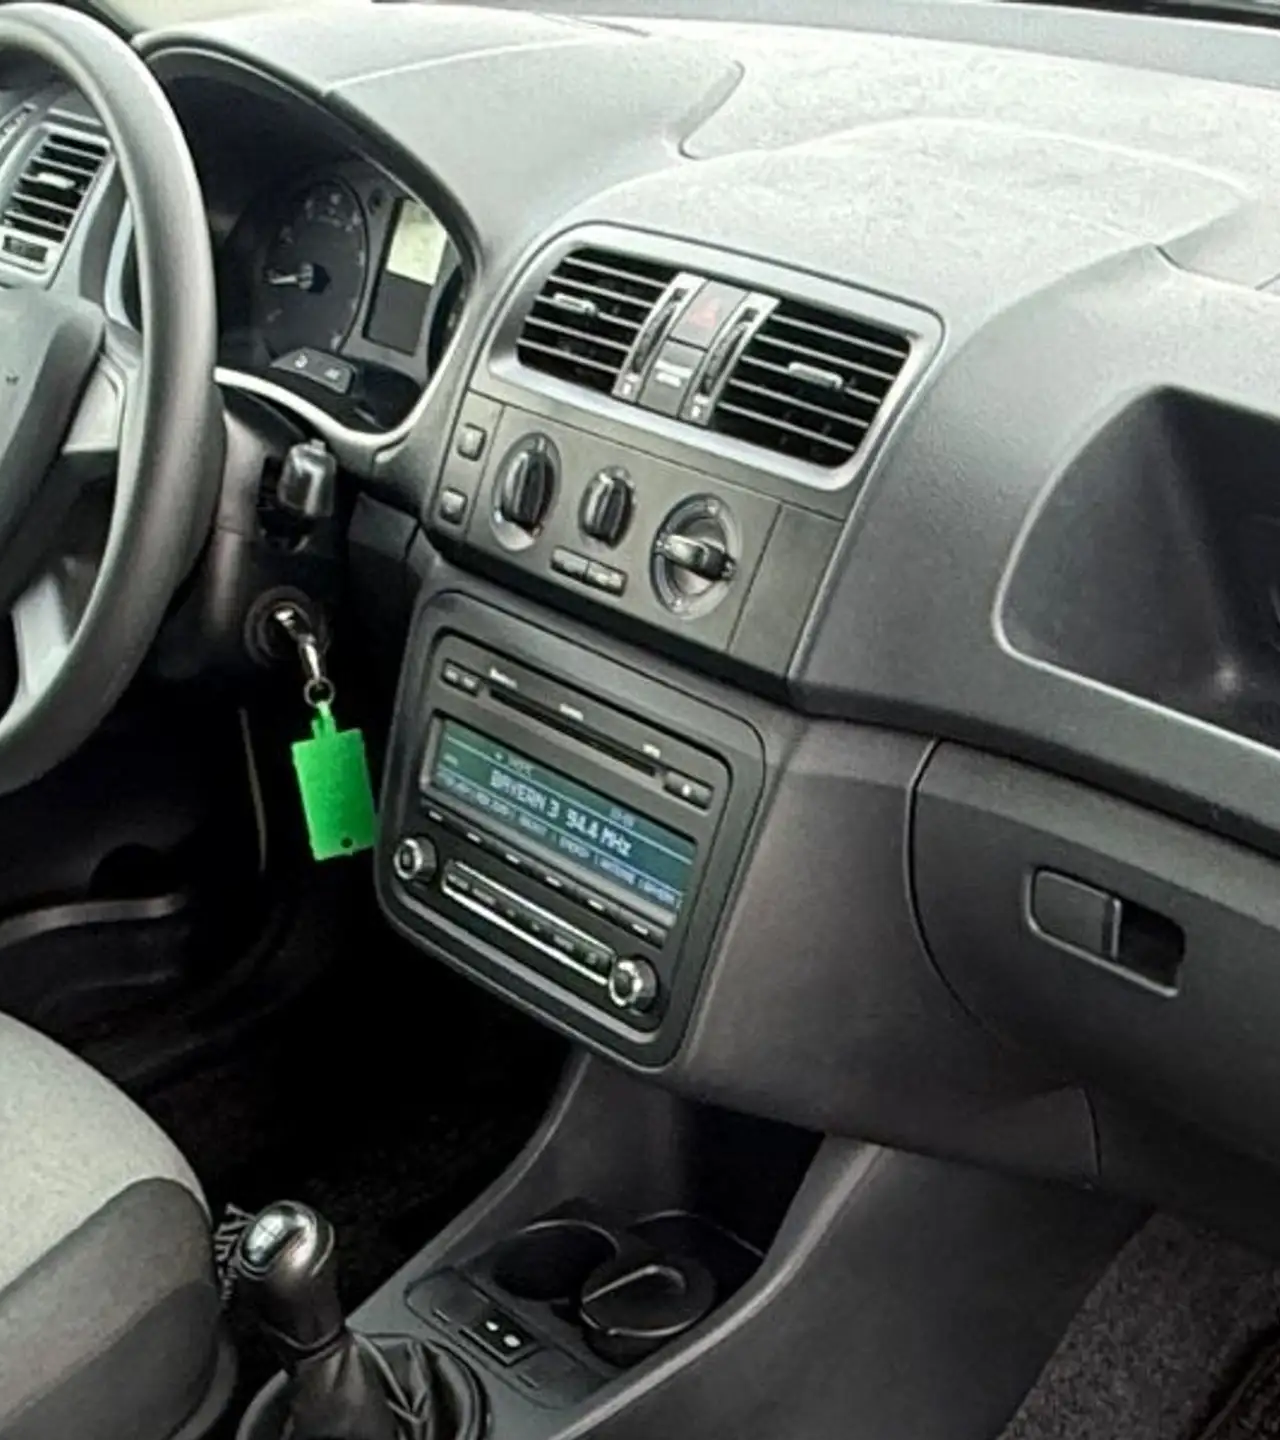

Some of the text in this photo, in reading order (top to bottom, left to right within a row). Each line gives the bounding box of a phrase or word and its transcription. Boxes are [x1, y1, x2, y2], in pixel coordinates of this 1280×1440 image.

[490, 769, 547, 813] BAYERN
[547, 798, 561, 819] 3
[600, 825, 633, 858] MHz
